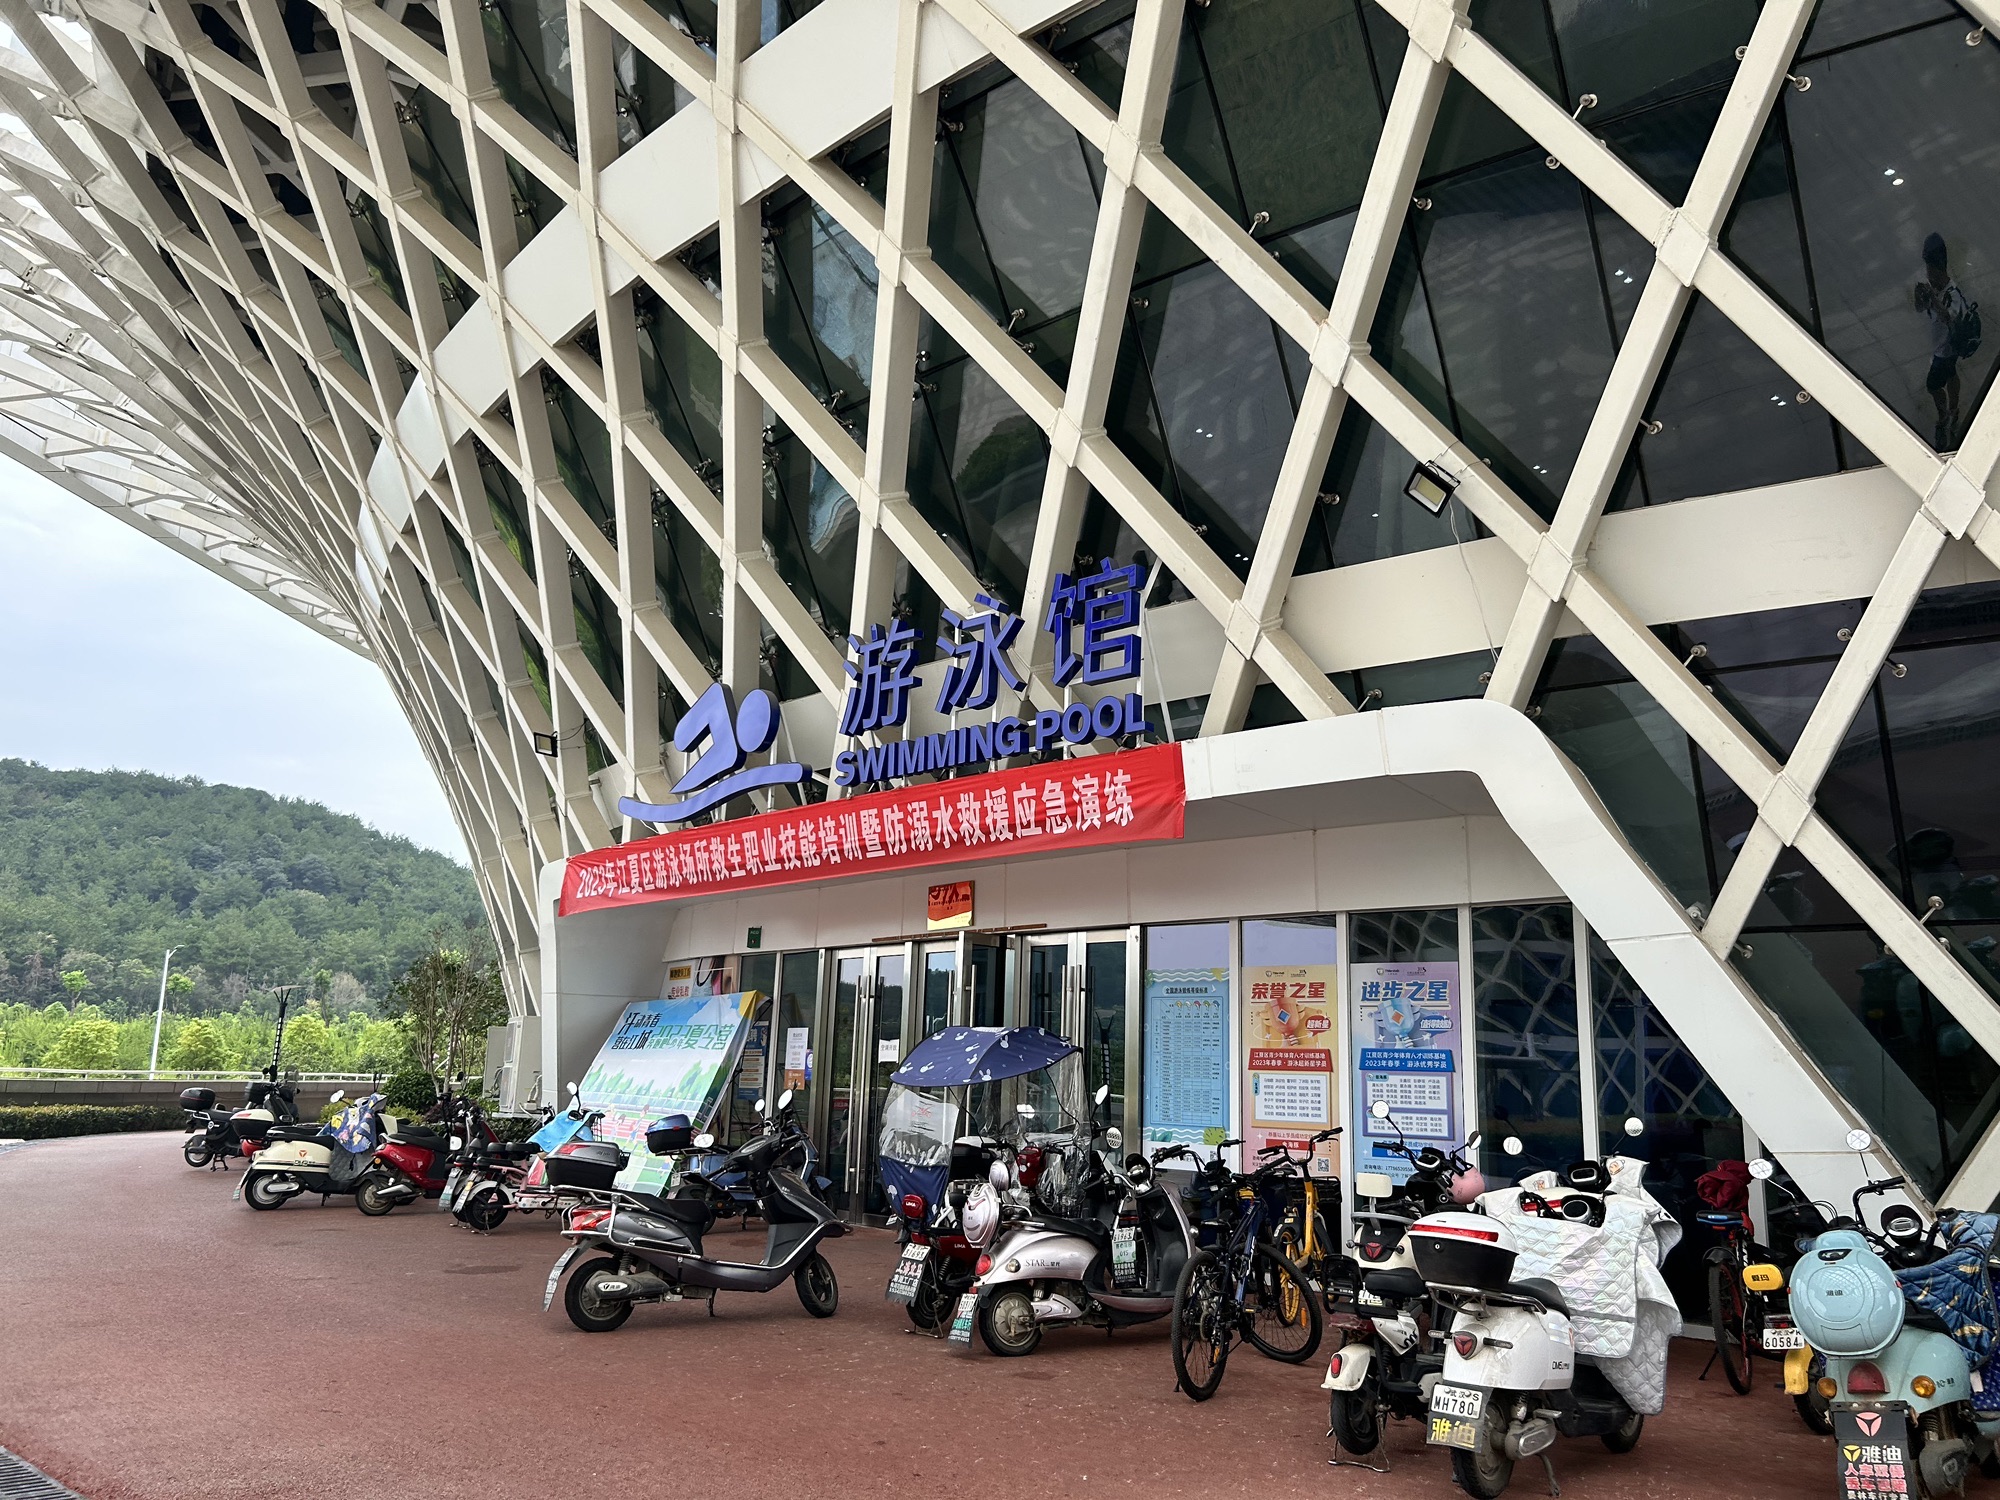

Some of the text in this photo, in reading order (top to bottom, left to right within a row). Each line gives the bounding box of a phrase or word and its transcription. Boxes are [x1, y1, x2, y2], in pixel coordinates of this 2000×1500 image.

[840, 559, 1146, 738] 游泳馆
[836, 692, 1154, 788] SWIMMING POOL
[1251, 981, 1326, 1000] 荣誉之星
[1360, 980, 1449, 1002] 进步之星
[1025, 1258, 1046, 1268] STAR
[1764, 1336, 1799, 1348] 60584
[1433, 1395, 1475, 1416] MH780
[1472, 1393, 1480, 1402] S
[1431, 1418, 1476, 1449] 雅迪
[1861, 1444, 1904, 1464] 雅迪
[1844, 1463, 1905, 1479] 人车双保
